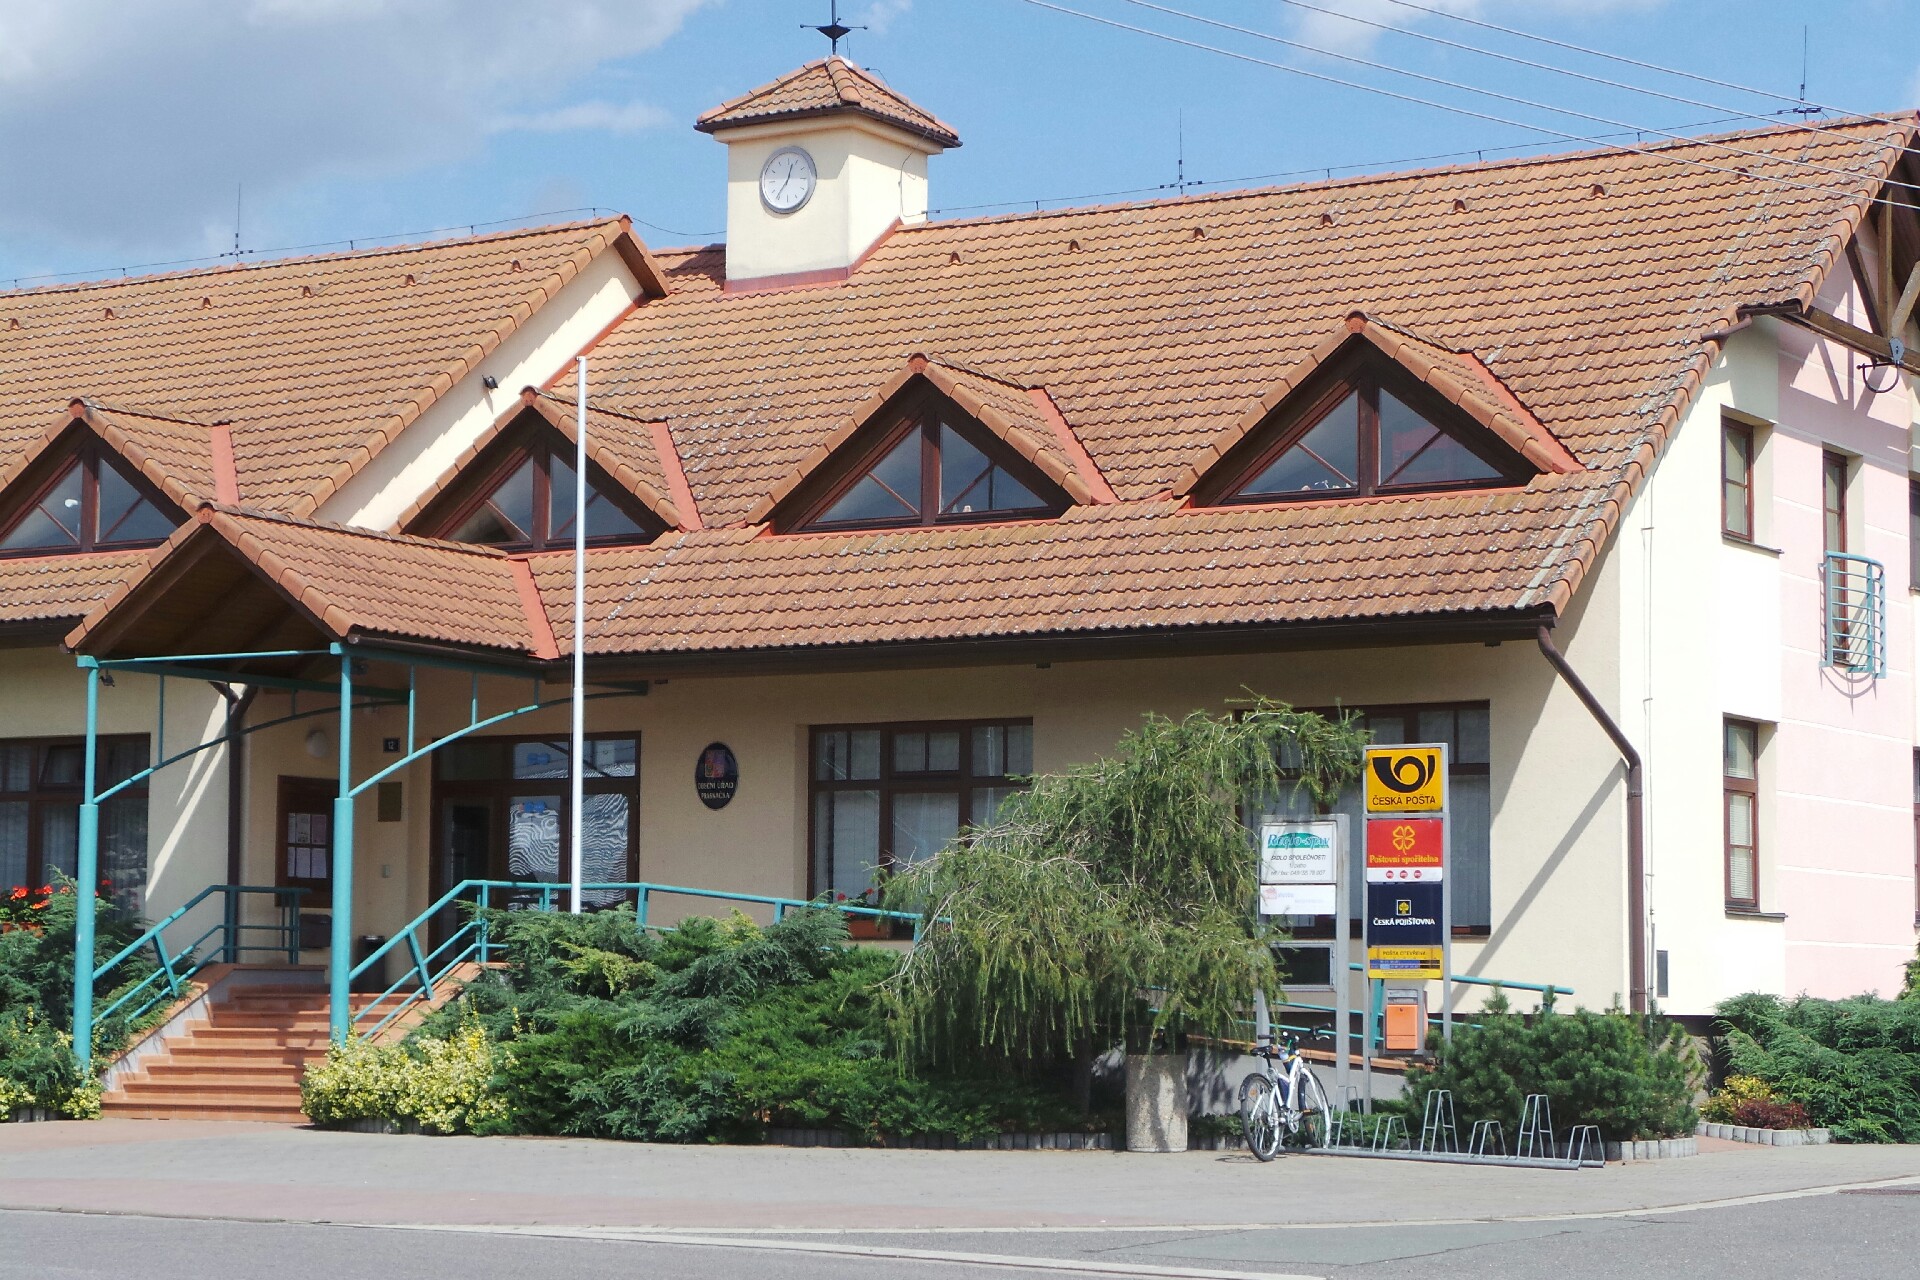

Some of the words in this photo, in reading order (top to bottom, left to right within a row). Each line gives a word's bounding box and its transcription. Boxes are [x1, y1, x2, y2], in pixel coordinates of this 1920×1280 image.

[1372, 795, 1403, 805] ČESKÁ
[1405, 794, 1436, 805] POŠTA
[1369, 855, 1400, 863] Poštovní
[1401, 855, 1439, 865] spořitelna
[1373, 918, 1395, 926] ČESKÁ
[1395, 917, 1435, 926] POJIŠŤOVNA
